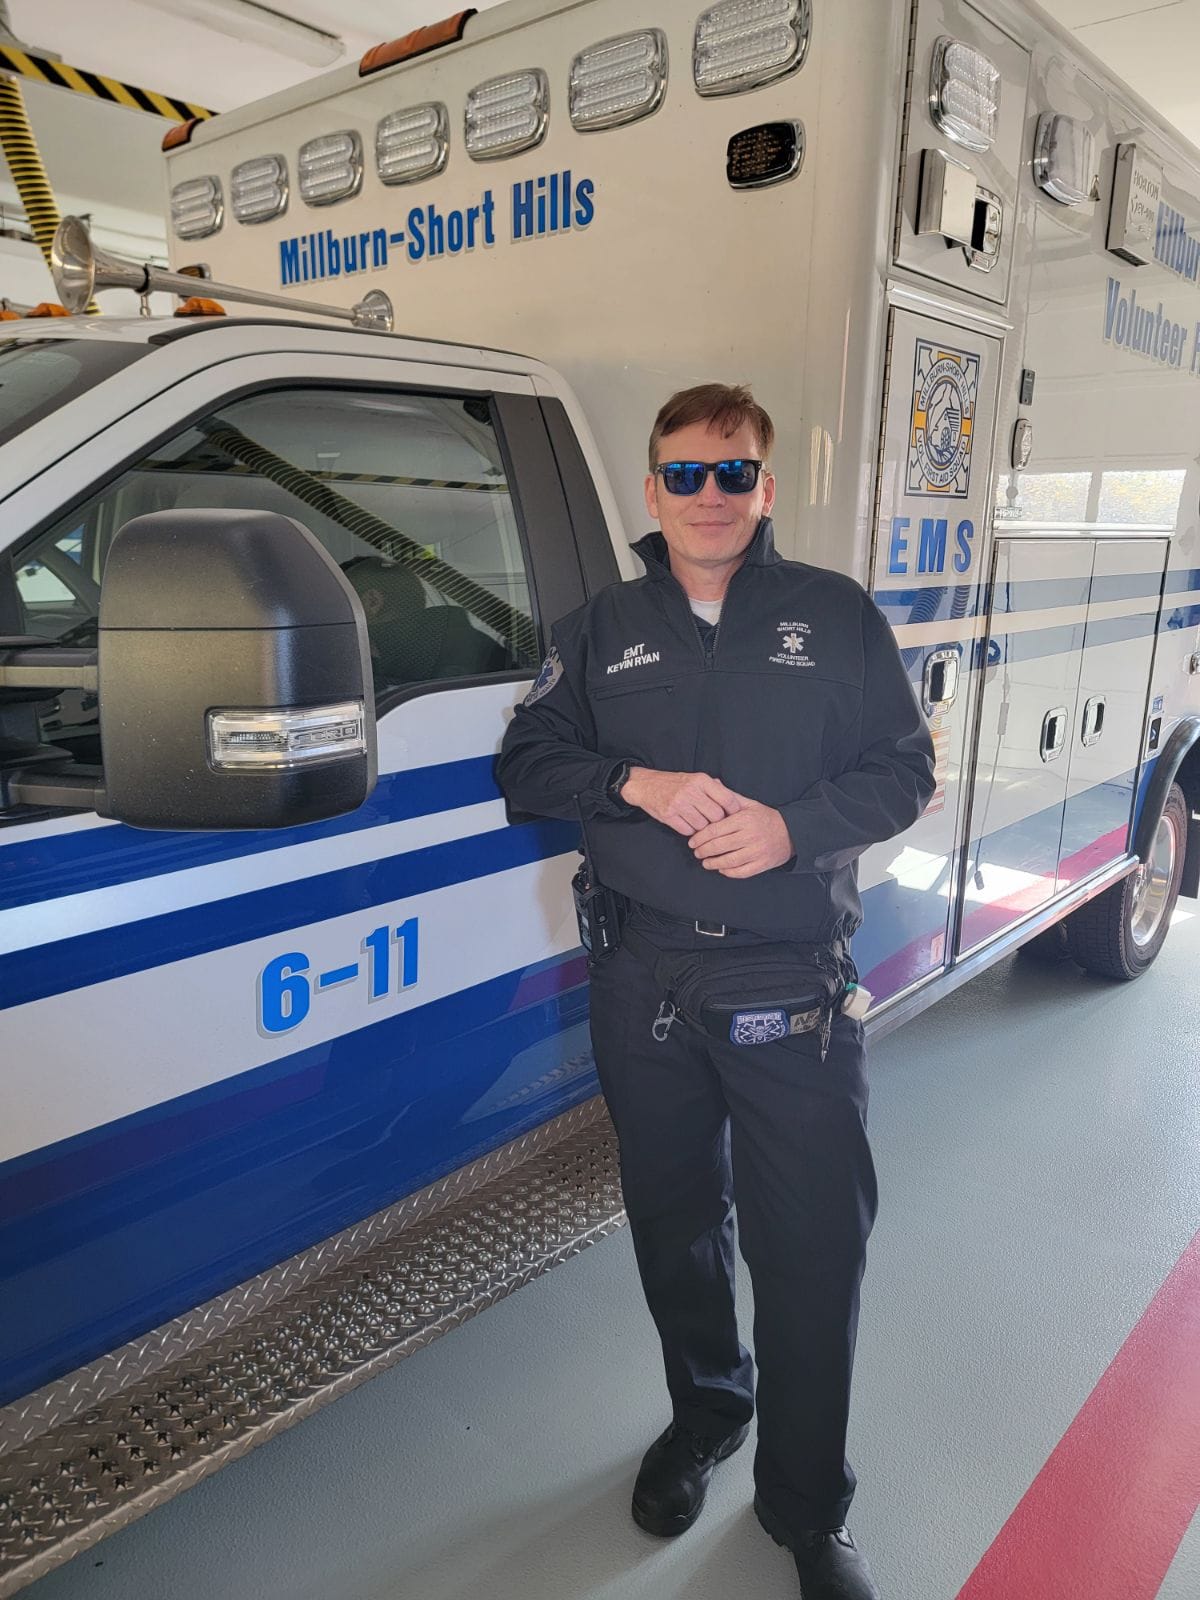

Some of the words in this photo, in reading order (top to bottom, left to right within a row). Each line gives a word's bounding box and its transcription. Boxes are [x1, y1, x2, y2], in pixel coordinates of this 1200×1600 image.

[279, 188, 496, 288] Millburn-Short
[511, 169, 595, 242] Hills
[1104, 276, 1188, 368] Volunteer
[923, 462, 939, 484] FIRST
[938, 471, 949, 484] AID
[949, 441, 967, 478] SQUAD
[887, 517, 974, 575] EMS
[606, 658, 634, 675] KEVIN
[634, 651, 660, 667] RYAN
[623, 643, 646, 660] EMT
[257, 916, 419, 1038] 6-11
